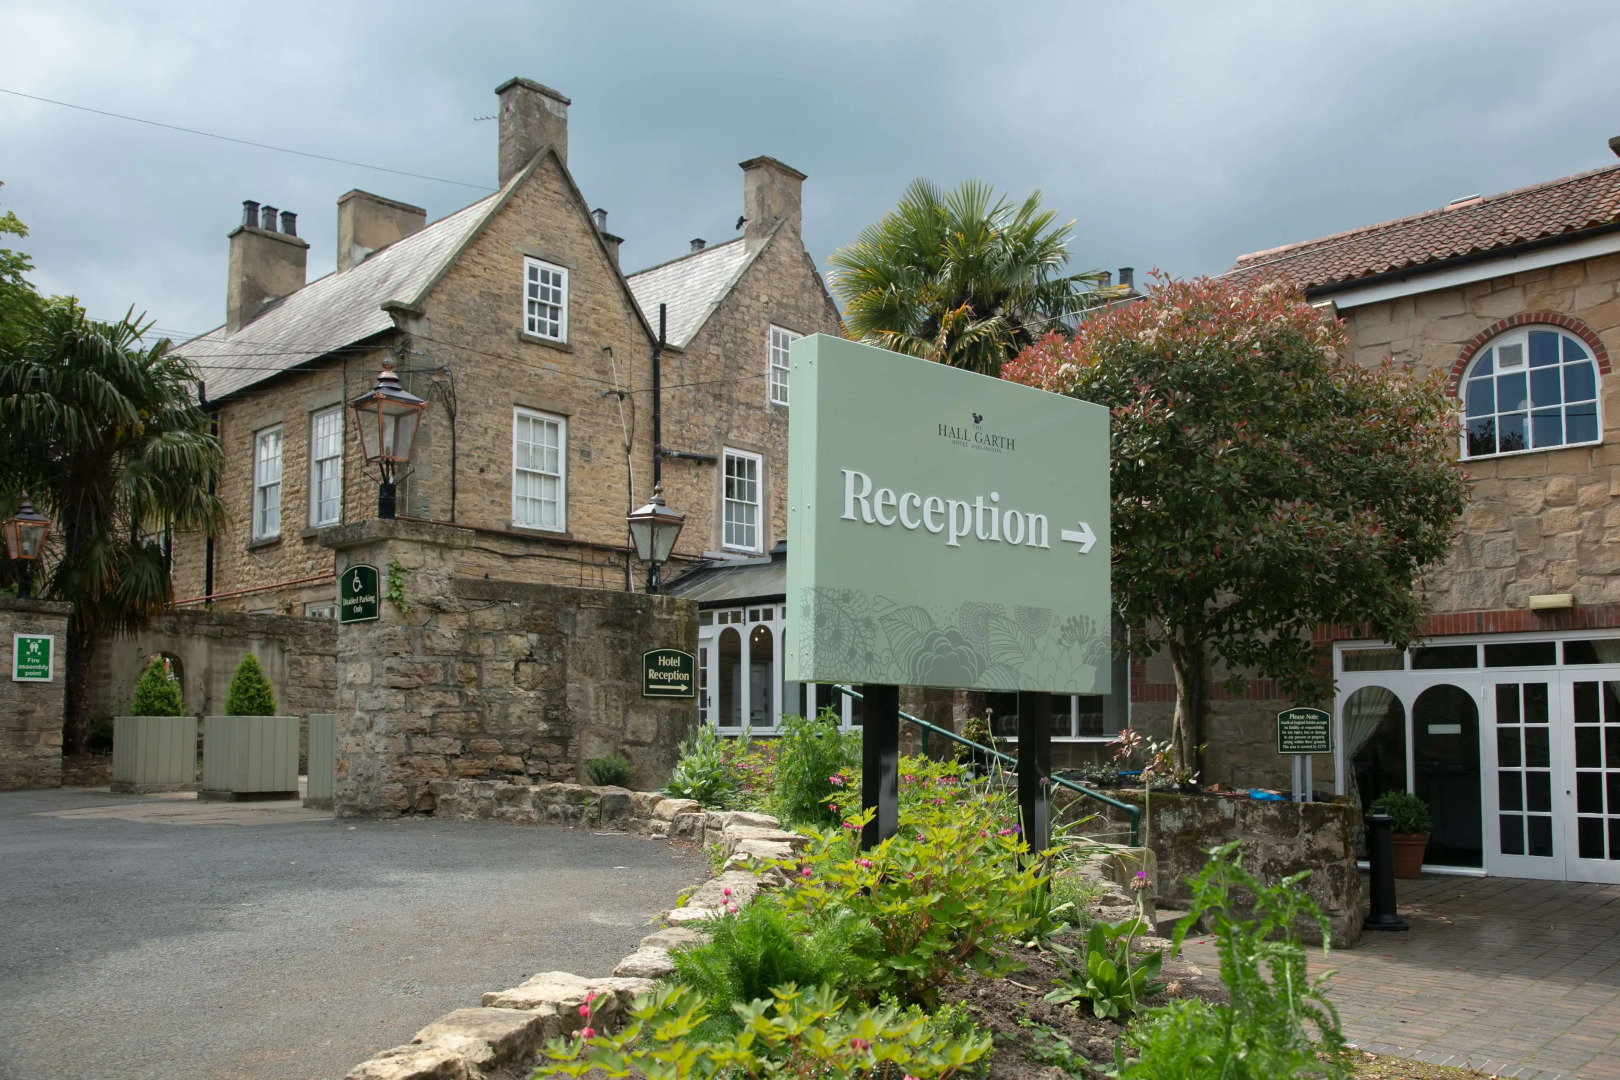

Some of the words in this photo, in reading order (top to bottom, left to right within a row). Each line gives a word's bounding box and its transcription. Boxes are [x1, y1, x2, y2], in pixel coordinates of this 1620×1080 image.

[938, 424, 970, 442] HALL
[974, 431, 1015, 450] GARTH
[971, 444, 1002, 454] DARLINGTON
[840, 468, 1050, 549] Reception
[342, 596, 358, 606] Disabled
[359, 595, 375, 604] Parking
[353, 605, 363, 614] Only
[658, 656, 680, 667] Hotel
[648, 669, 689, 683] Reception
